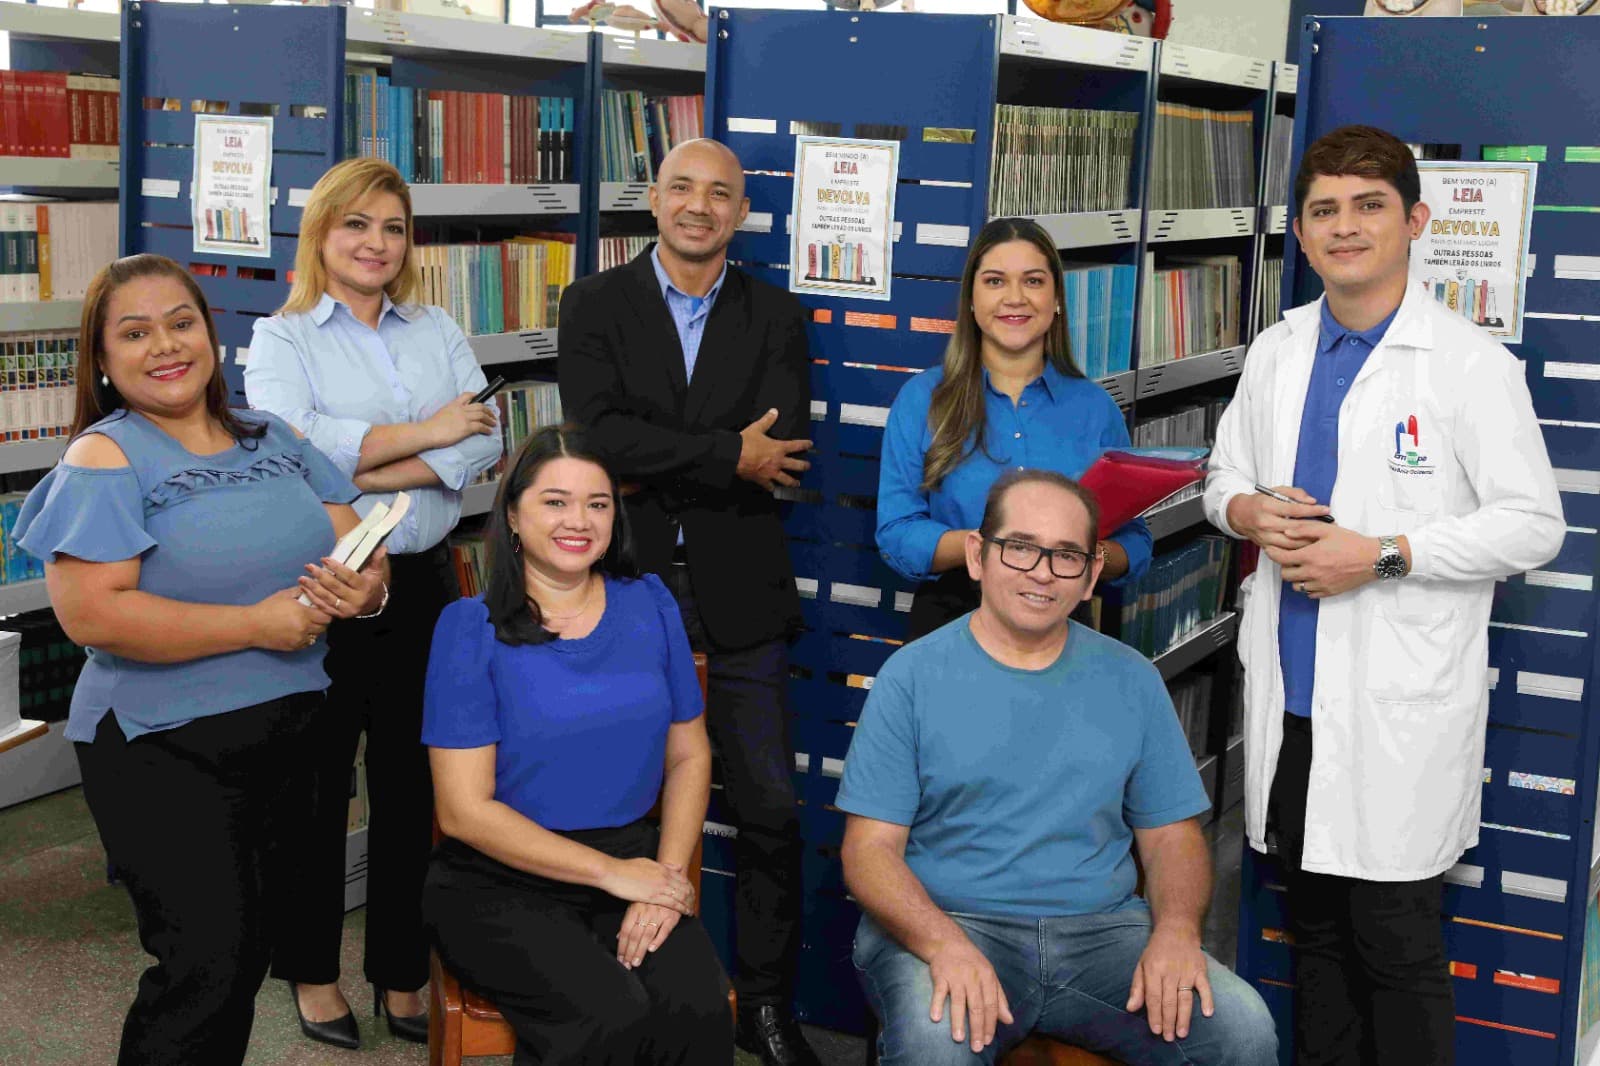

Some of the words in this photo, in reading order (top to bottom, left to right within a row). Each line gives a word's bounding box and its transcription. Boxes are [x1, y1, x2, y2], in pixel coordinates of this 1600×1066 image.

[224, 136, 243, 148] LEIA
[212, 160, 253, 174] DEVOLVA
[833, 161, 858, 174] LEIA
[1442, 177, 1458, 185] BEM
[1460, 178, 1485, 186] VINDO
[817, 187, 870, 205] DEVOLVA
[1452, 187, 1483, 203] LEIA
[1448, 207, 1487, 216] EMPRESTE
[1430, 219, 1501, 237] DEVOLVA
[1433, 249, 1461, 257] OUTRAS
[1462, 250, 1494, 258] PESSOAS
[1424, 258, 1449, 266] TAMBÉM
[1449, 258, 1470, 267] LERÃO
[1480, 260, 1502, 268] LIVROS
